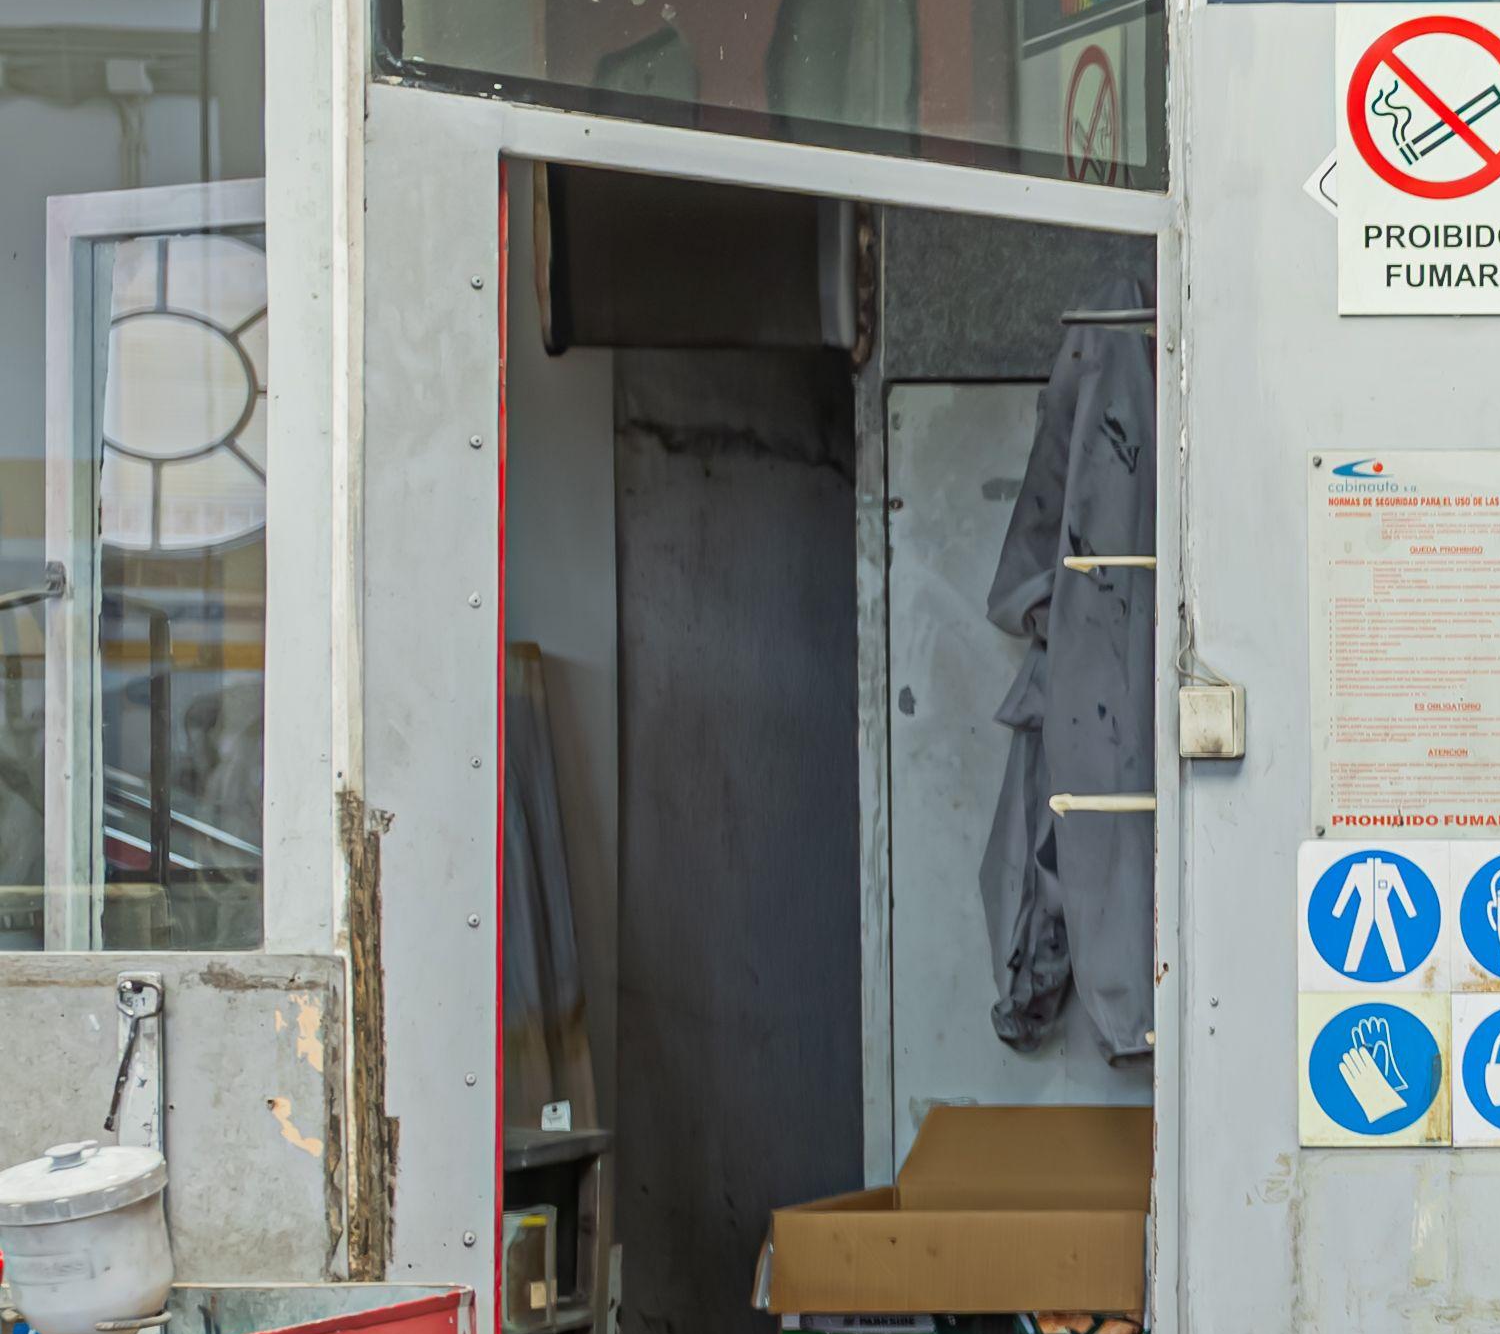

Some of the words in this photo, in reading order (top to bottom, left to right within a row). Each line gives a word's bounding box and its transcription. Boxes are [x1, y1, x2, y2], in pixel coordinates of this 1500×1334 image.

[1385, 264, 1500, 288] FUMAR
[1327, 479, 1399, 493] cabinauto
[1328, 497, 1360, 507] NORMAS
[1363, 497, 1373, 507] DE
[1375, 497, 1419, 507] SEGURIDAD
[1421, 497, 1441, 507] PARA
[1443, 497, 1451, 507] EL
[1455, 497, 1471, 507] USO
[1473, 497, 1483, 507] DE
[1485, 497, 1499, 507] LAS
[1409, 546, 1437, 555] QUEDA
[1440, 546, 1484, 555] PROHIBIDO
[1414, 703, 1425, 711] ES
[1427, 703, 1481, 711] OBLIGATORIO
[1331, 814, 1439, 827] PROHIBIDO
